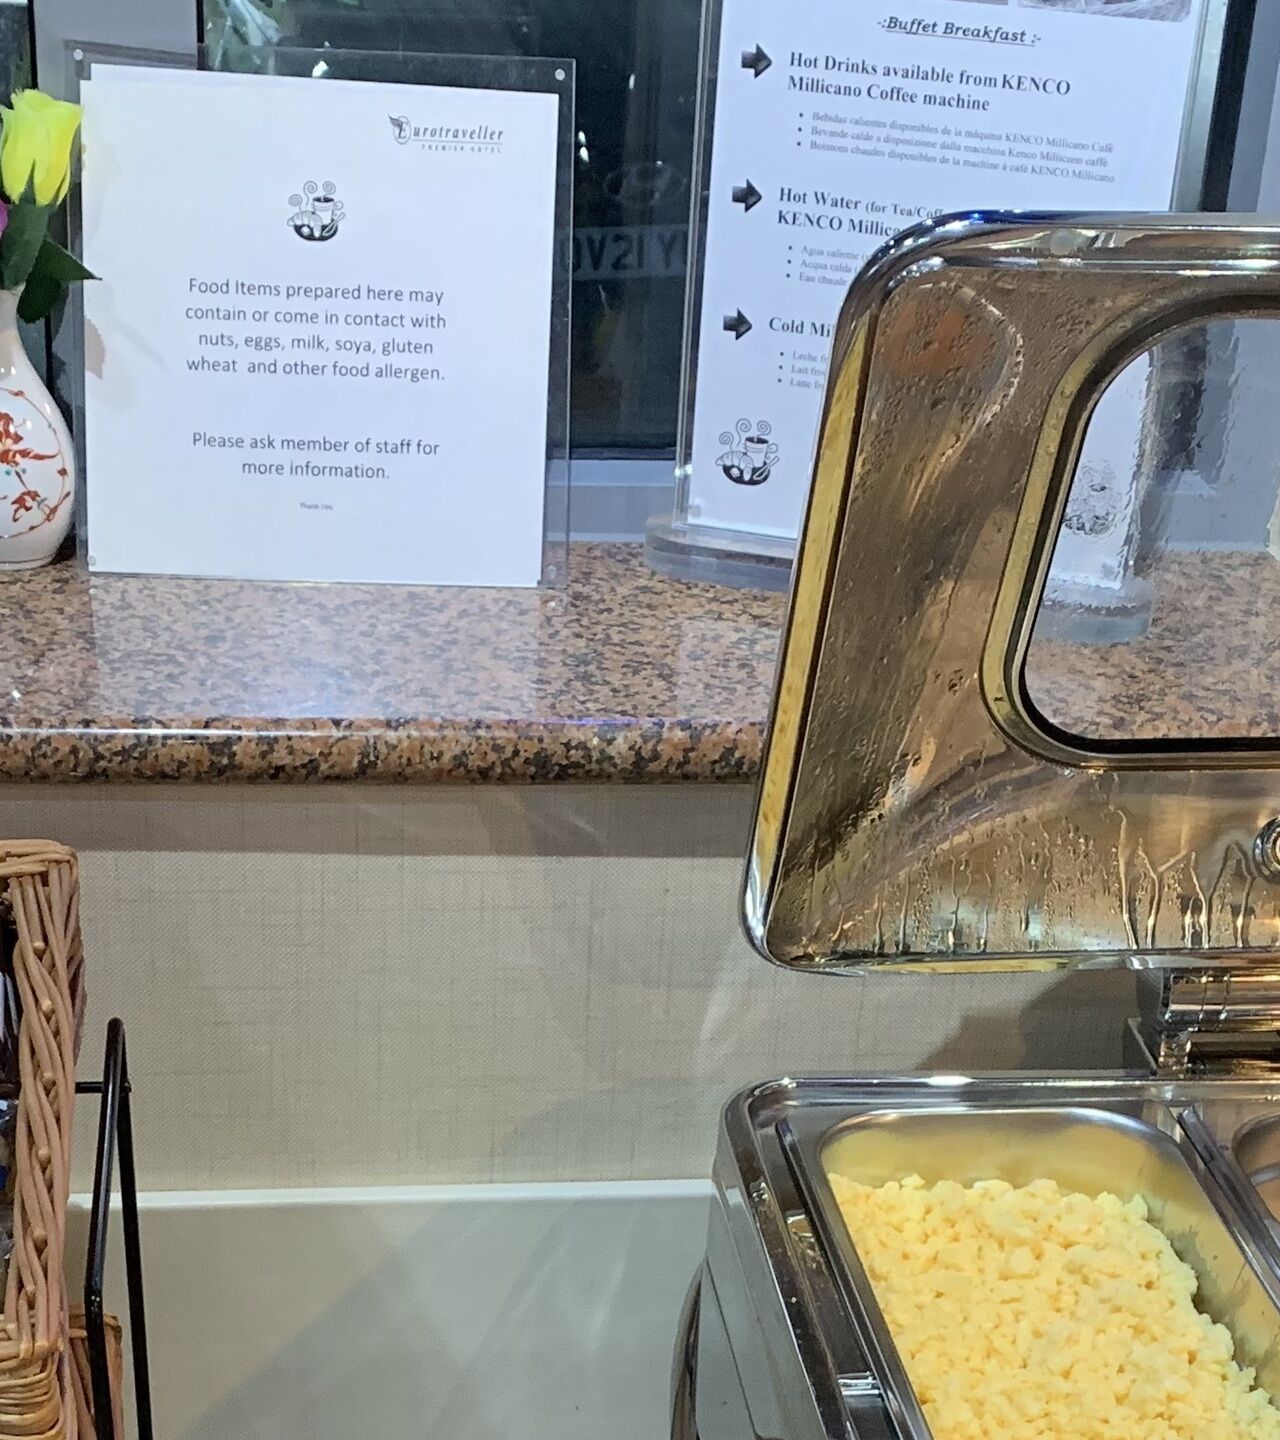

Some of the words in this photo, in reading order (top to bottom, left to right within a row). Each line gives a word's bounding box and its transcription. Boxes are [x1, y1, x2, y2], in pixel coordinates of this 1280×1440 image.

[942, 22, 1026, 43] Breakfast
[790, 52, 819, 69] Hot
[825, 56, 877, 75] Drinks
[883, 65, 954, 83] available
[959, 70, 997, 88] from
[1001, 74, 1071, 95] KENCO
[788, 75, 862, 97] Millicano
[867, 84, 918, 103] Coffee
[923, 91, 989, 111] machine
[394, 117, 503, 140] Eurotraveller
[889, 120, 939, 134] disponibles
[941, 126, 951, 135] de
[1005, 133, 1043, 145] KENCO
[1046, 137, 1089, 150] Millicano
[888, 149, 937, 163] disponibles
[939, 155, 949, 164] de
[953, 157, 960, 166] la
[963, 159, 1000, 169] machine
[1031, 166, 1070, 177] KENCO
[1072, 170, 1115, 183] Millicano
[1008, 148, 1037, 159] Kenco
[1040, 151, 1082, 165] Millicano
[780, 187, 807, 204] Hot
[814, 191, 861, 210] Water
[866, 201, 888, 213] (for
[778, 210, 843, 230] KENCO
[189, 278, 229, 294] Food
[235, 280, 281, 296] Items
[286, 284, 362, 300] prepared
[367, 285, 403, 301] here
[409, 288, 444, 305] may
[186, 307, 246, 320] contain
[252, 309, 269, 322] or
[275, 310, 319, 324] come
[325, 309, 339, 324] in
[344, 312, 405, 327] contact
[411, 314, 446, 328] with
[769, 317, 804, 334] Cold
[810, 321, 835, 338] Mi
[198, 333, 238, 348] nuts,
[244, 337, 284, 351] eggs,
[291, 334, 329, 352] milk,
[335, 338, 376, 354] soya,
[382, 339, 433, 355] gluten
[793, 352, 817, 362] Leche
[186, 356, 238, 372] wheat
[247, 359, 277, 374] and
[283, 361, 327, 375] other
[333, 361, 369, 377] food
[375, 363, 445, 383] allergen.
[791, 365, 808, 376] Lait
[193, 432, 244, 448] Please
[250, 434, 275, 449] ask
[281, 436, 349, 451] member
[355, 438, 371, 452] of
[376, 439, 413, 454] staff
[417, 439, 440, 455] for
[242, 462, 284, 475] more
[290, 461, 389, 479] information.
